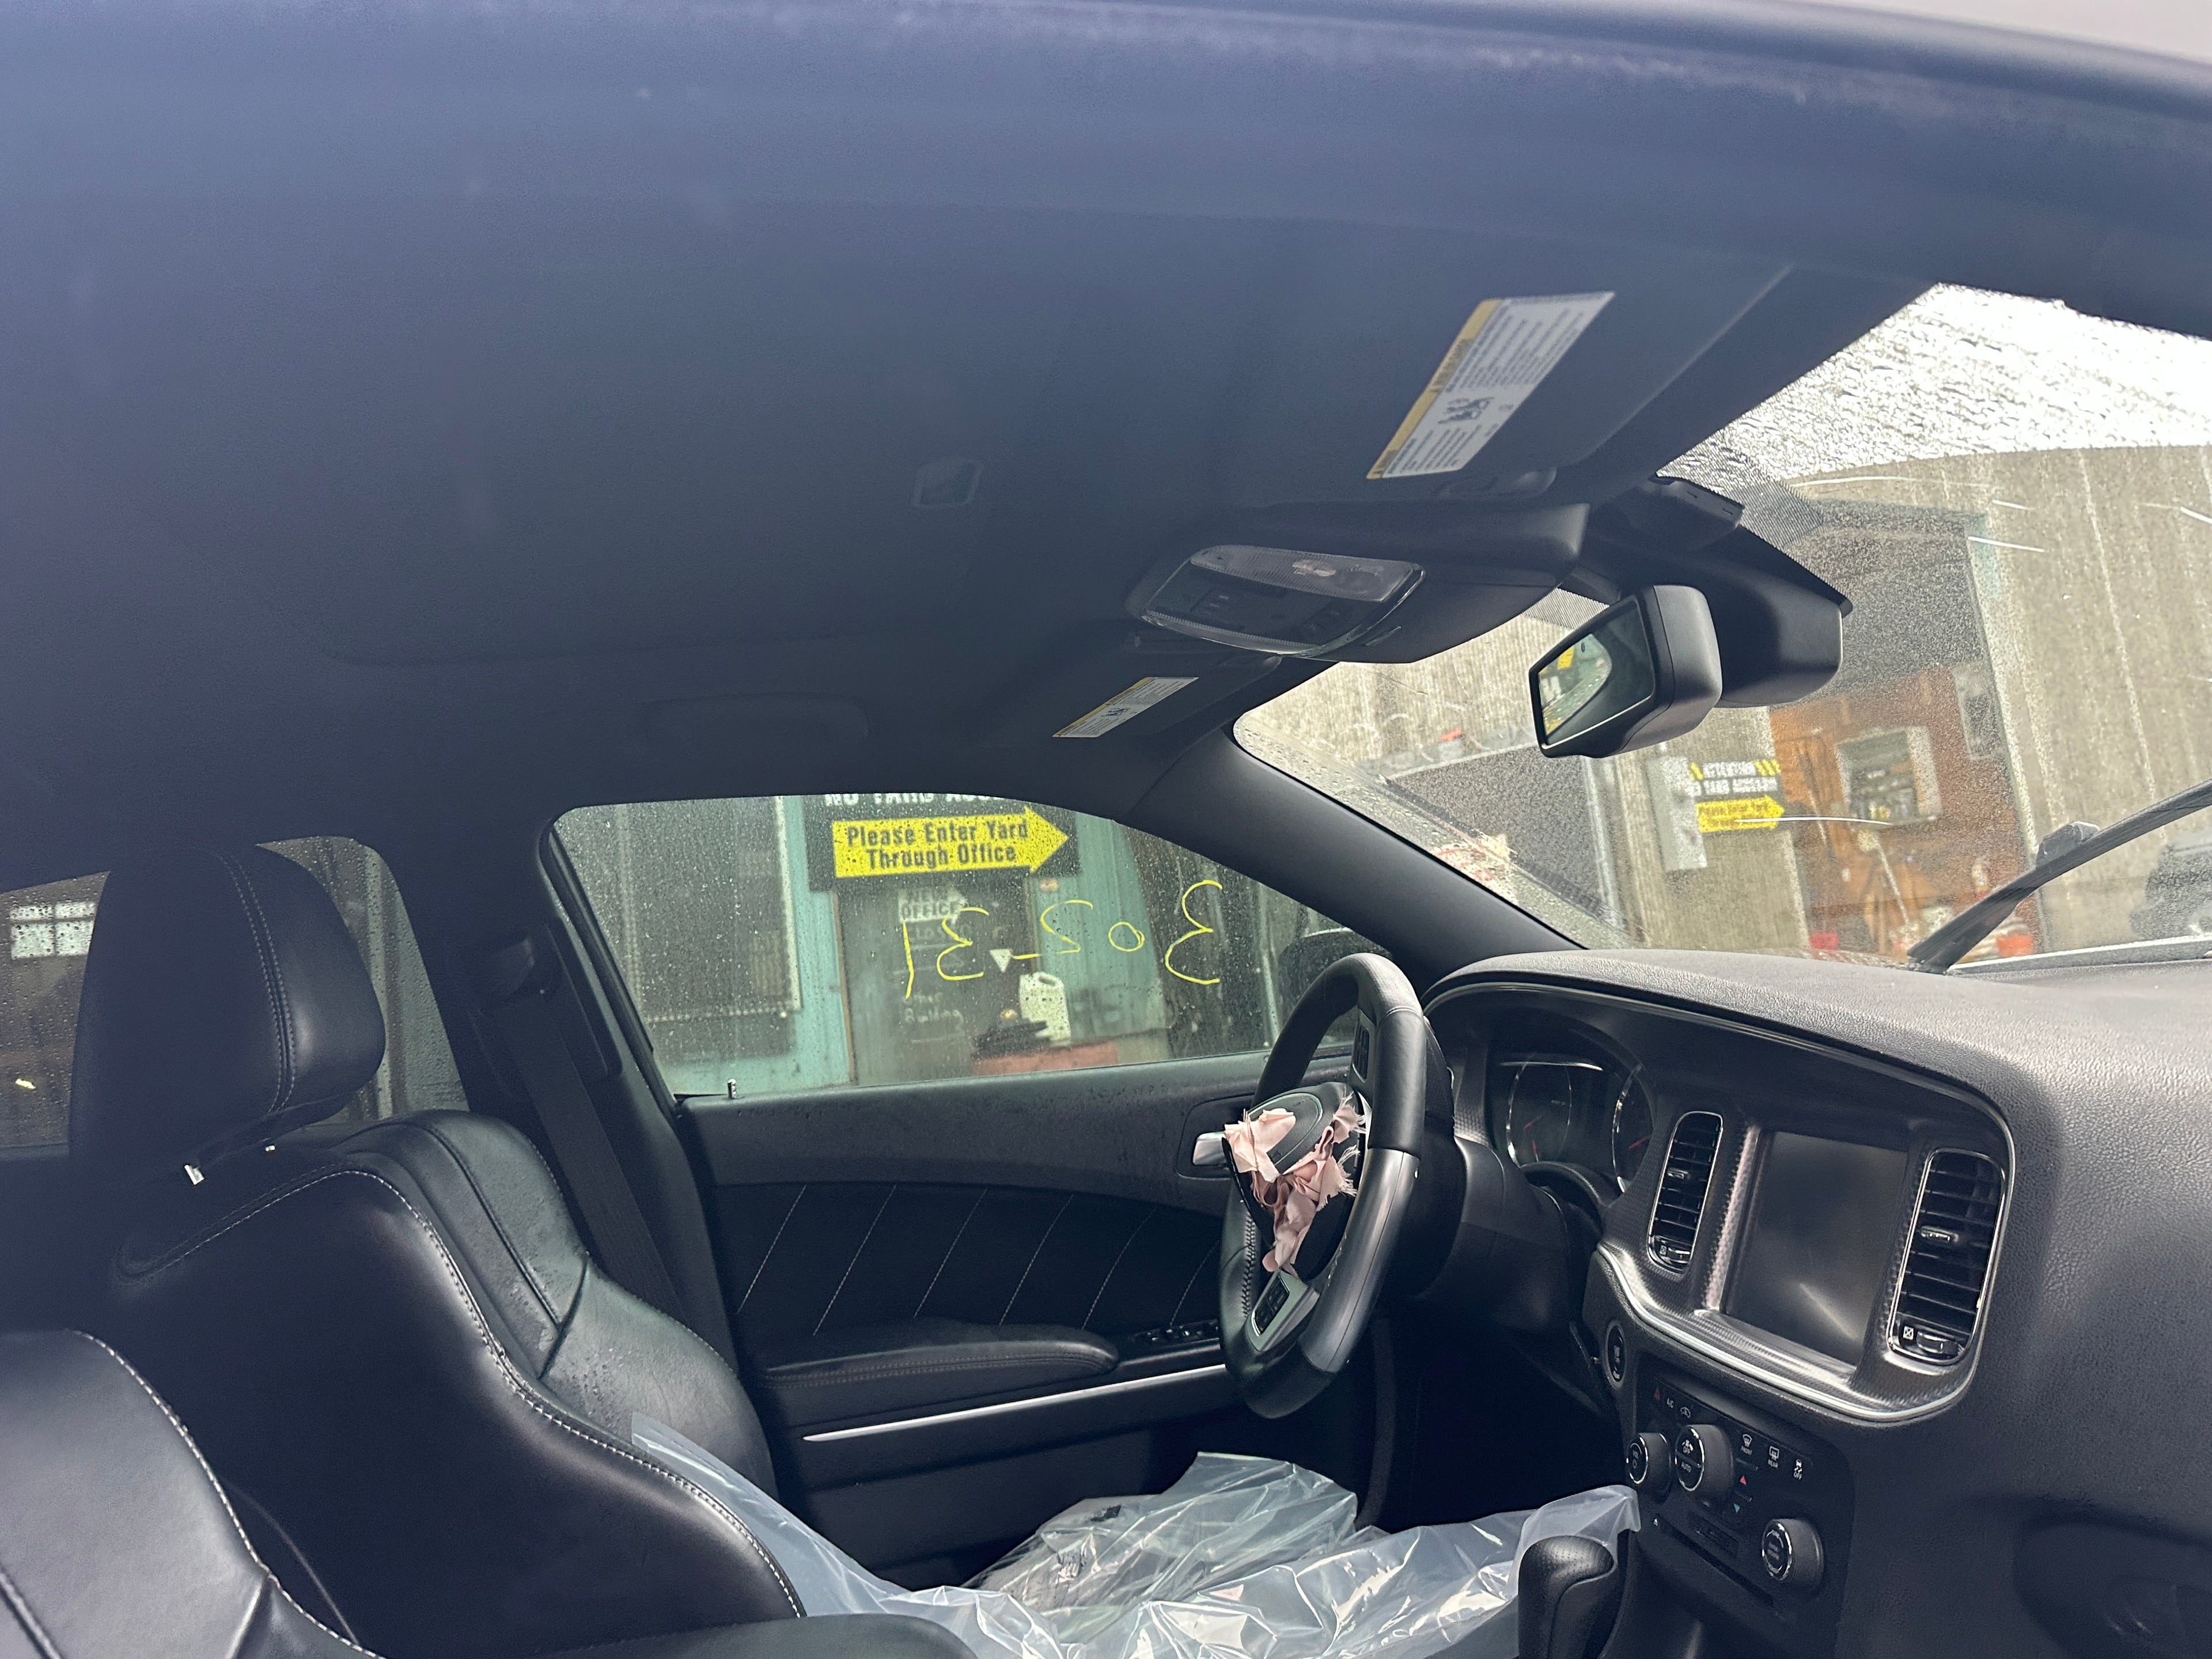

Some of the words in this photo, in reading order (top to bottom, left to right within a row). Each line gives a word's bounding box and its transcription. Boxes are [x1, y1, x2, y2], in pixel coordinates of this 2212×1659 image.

[847, 825, 915, 846] Please
[923, 821, 977, 843] Enter
[986, 818, 1028, 840] Yard
[866, 845, 949, 869] Through
[957, 843, 1017, 864] Office
